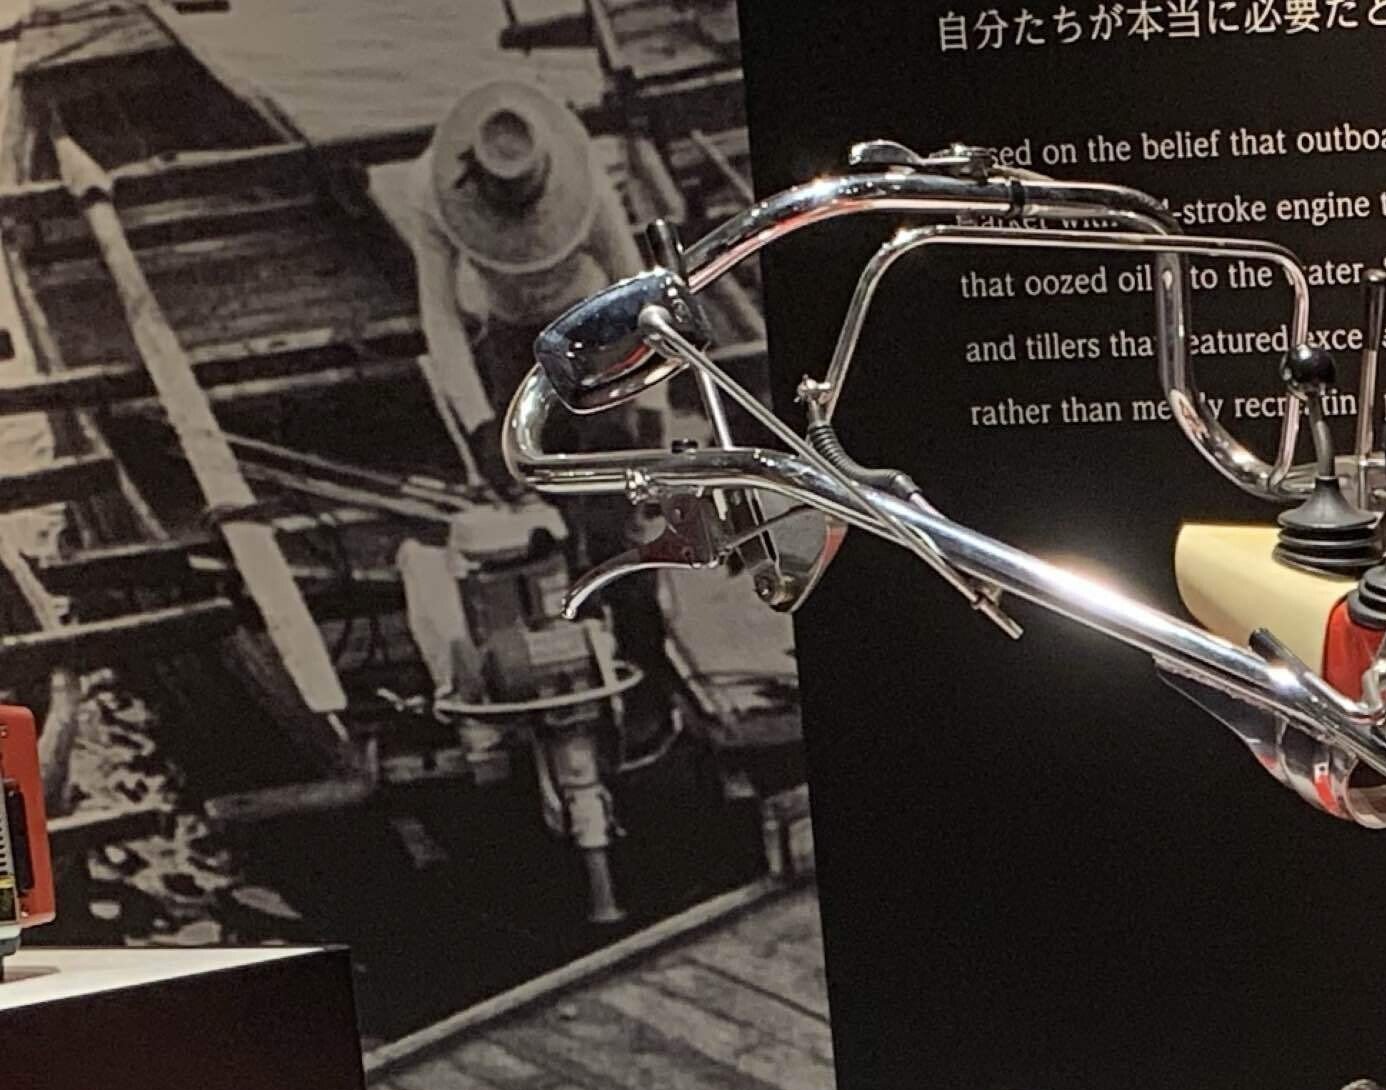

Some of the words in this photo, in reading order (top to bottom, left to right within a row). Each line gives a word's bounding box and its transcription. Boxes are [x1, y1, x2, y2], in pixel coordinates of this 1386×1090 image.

[991, 138, 1032, 167] sed
[1043, 143, 1077, 165] on
[1088, 134, 1131, 162] the
[1142, 129, 1221, 159] belief
[1230, 128, 1286, 156] that
[1162, 194, 1266, 225] -stroke
[1277, 192, 1369, 226] engine
[961, 271, 1014, 298] that
[1026, 266, 1107, 295] oozed
[1119, 264, 1152, 291] oil
[1228, 260, 1273, 289] the
[966, 334, 1015, 362] and
[1027, 333, 1099, 360] tillers
[1110, 329, 1157, 357] tha
[1189, 324, 1288, 355] eatured
[971, 398, 1050, 426] rather
[1062, 396, 1121, 423] than
